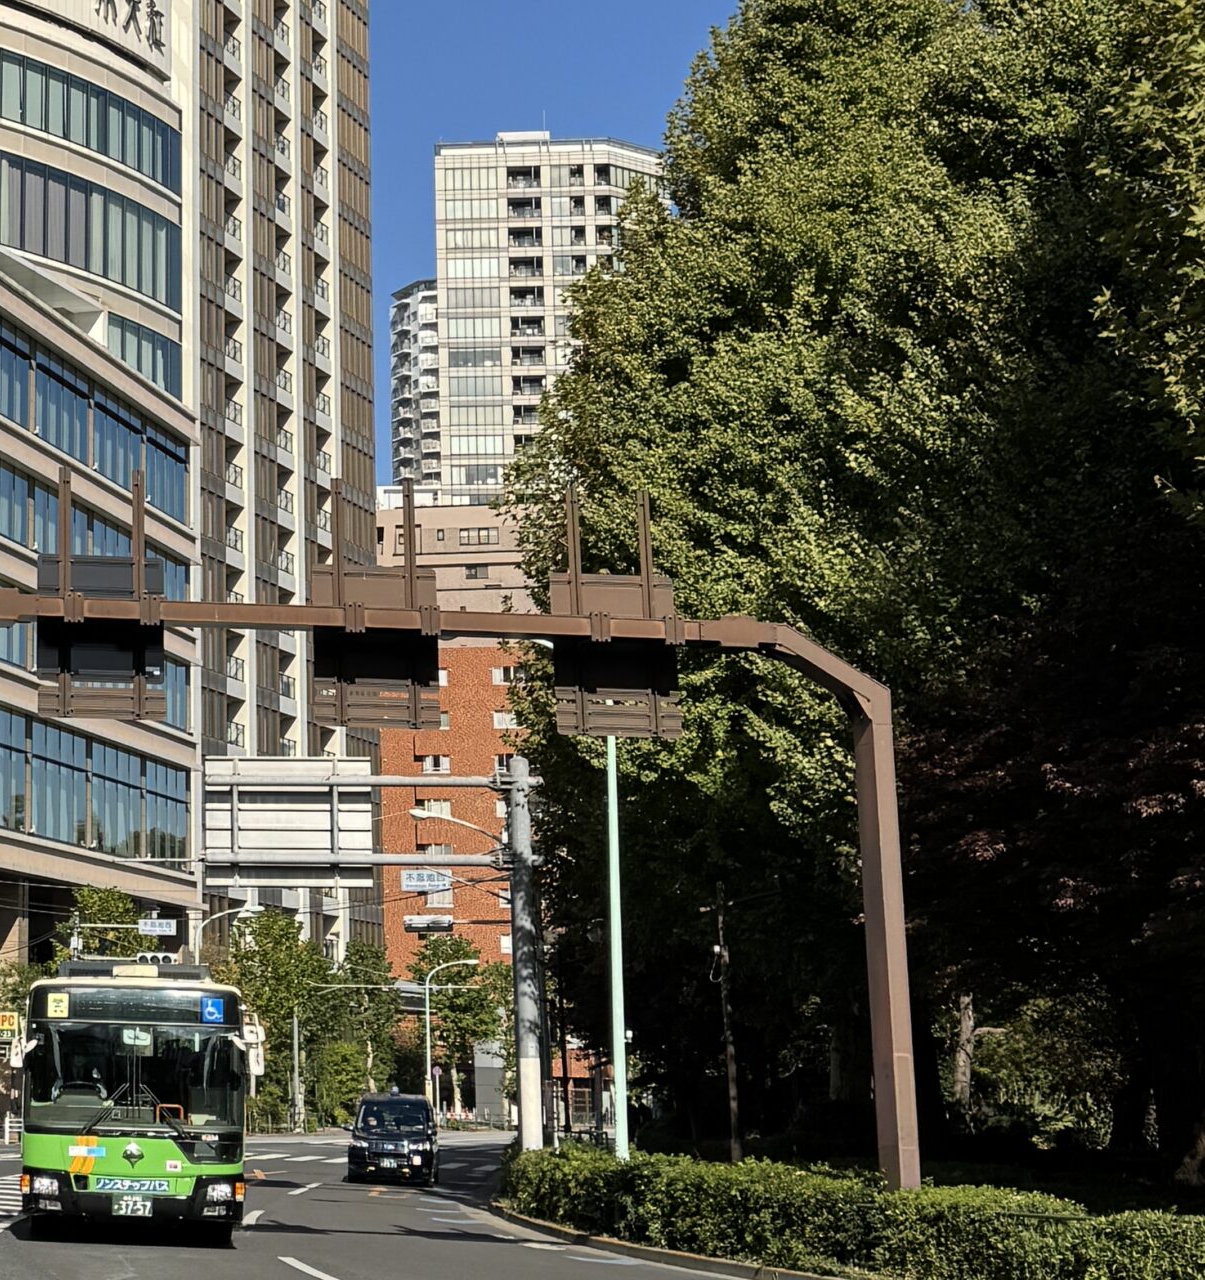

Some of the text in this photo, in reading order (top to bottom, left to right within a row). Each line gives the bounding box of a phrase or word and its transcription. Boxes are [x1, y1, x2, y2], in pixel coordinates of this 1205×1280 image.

[96, 1178, 170, 1192] ノンステップバス
